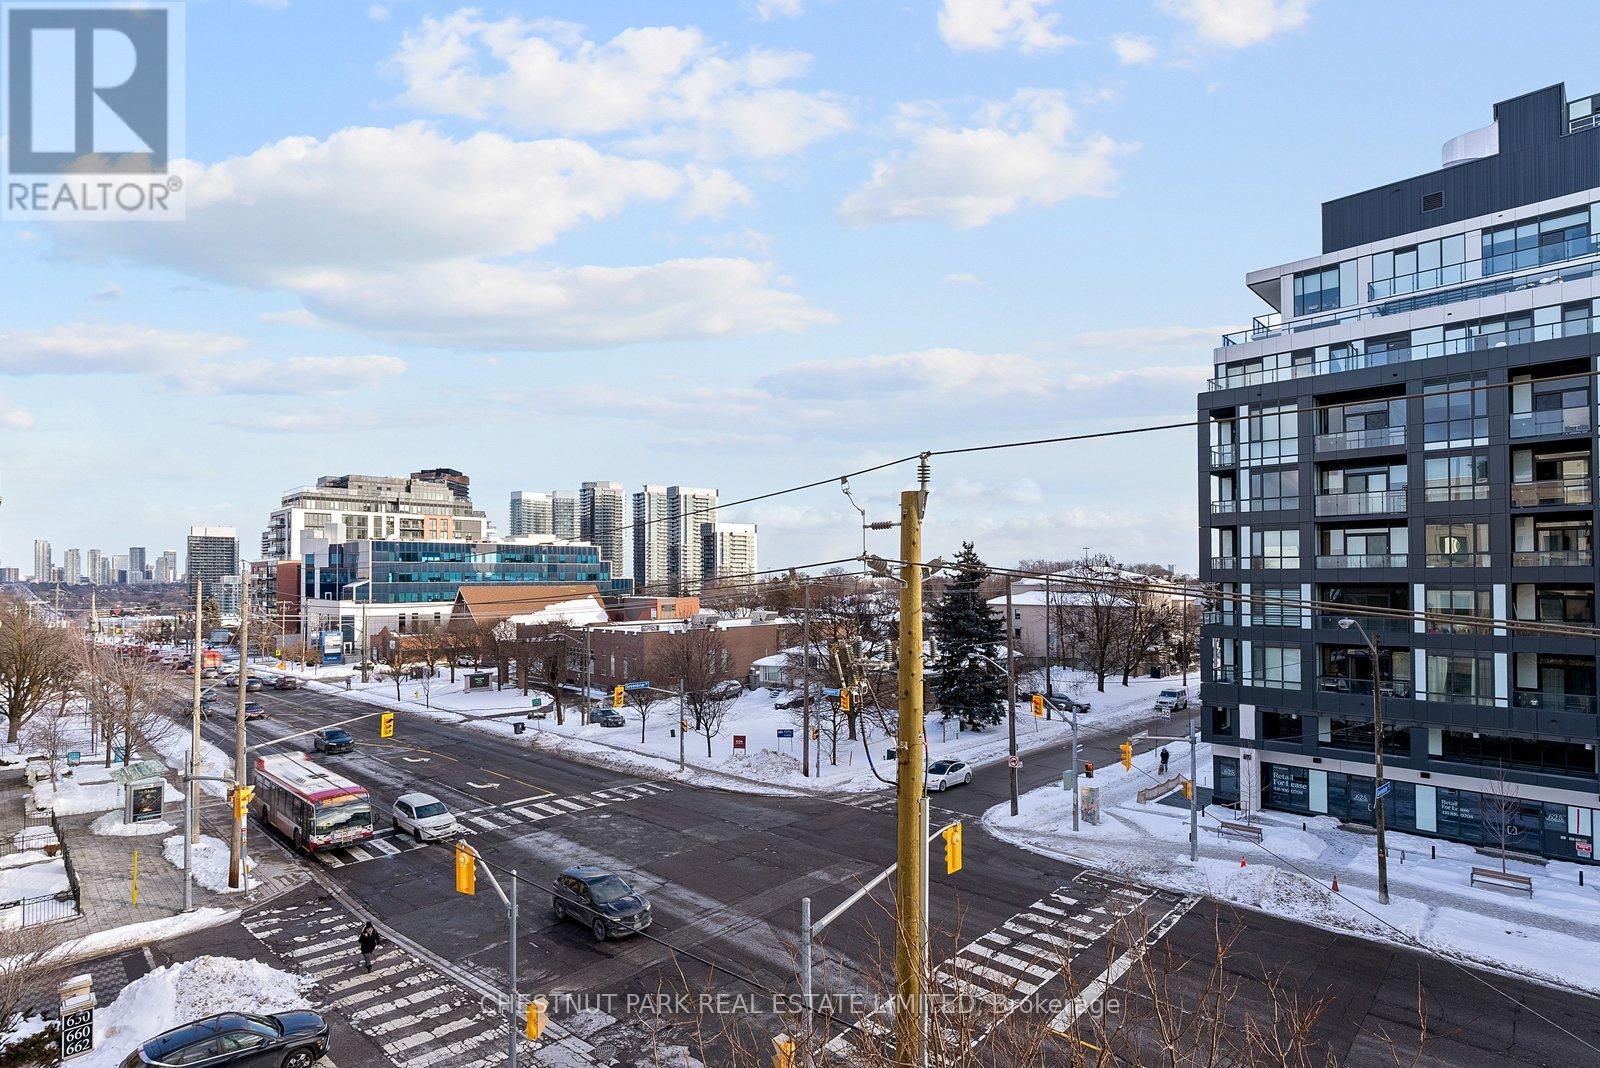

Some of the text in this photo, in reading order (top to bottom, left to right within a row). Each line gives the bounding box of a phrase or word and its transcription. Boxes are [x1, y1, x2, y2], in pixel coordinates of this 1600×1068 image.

[1273, 772, 1294, 781] Retail
[1273, 779, 1285, 787] For
[66, 1026, 90, 1042] 660
[66, 1038, 90, 1055] 662
